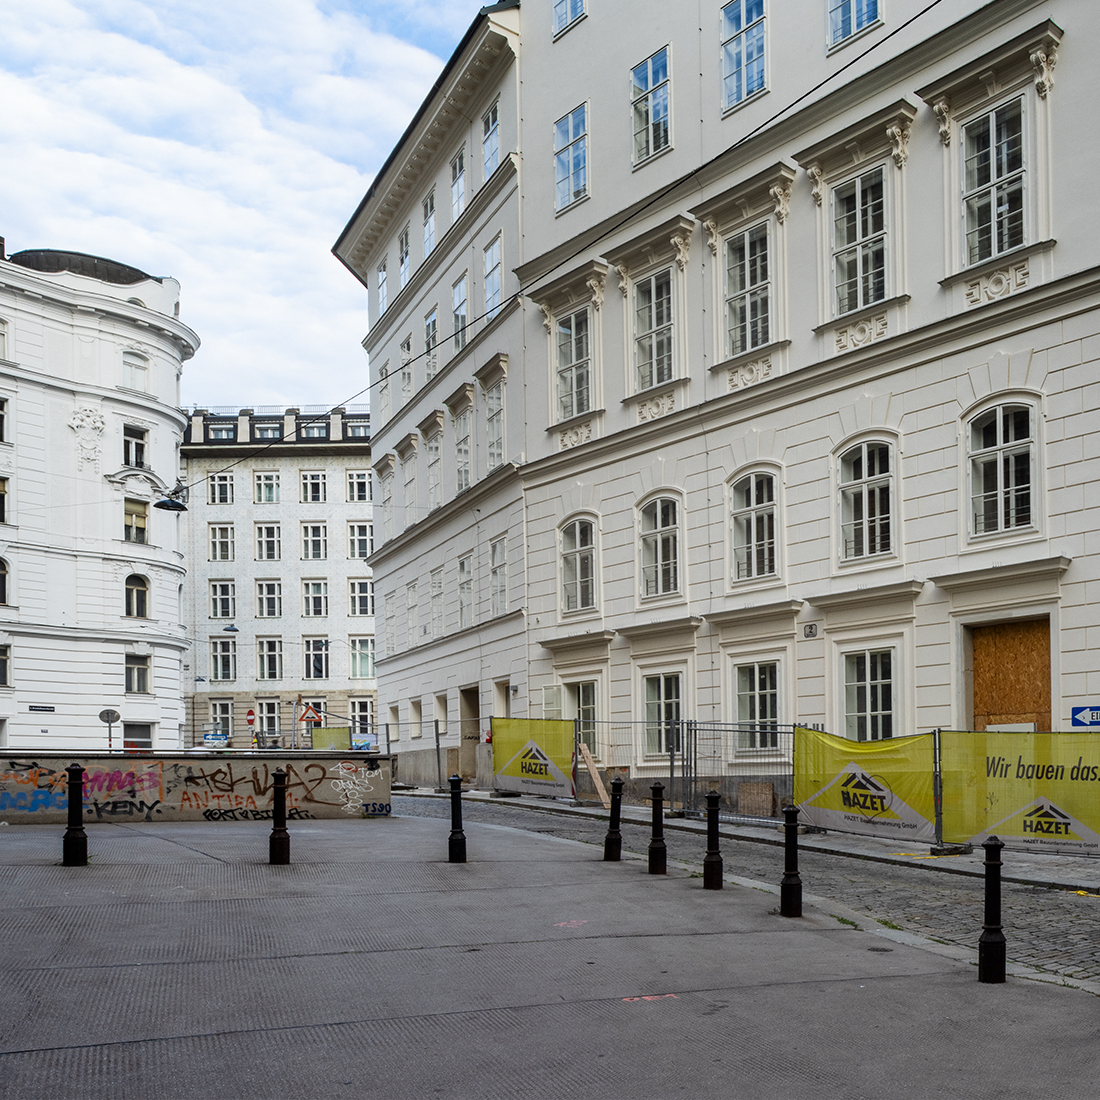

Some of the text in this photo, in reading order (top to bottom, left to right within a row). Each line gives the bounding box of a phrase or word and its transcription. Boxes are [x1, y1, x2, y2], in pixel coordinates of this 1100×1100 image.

[521, 762, 549, 775] HAZET
[986, 756, 1012, 778] Wir
[1016, 755, 1065, 780] bauen
[841, 790, 886, 812] HAZET
[1023, 820, 1071, 835] HAZET
[1040, 840, 1082, 848] Bauunternehmung
